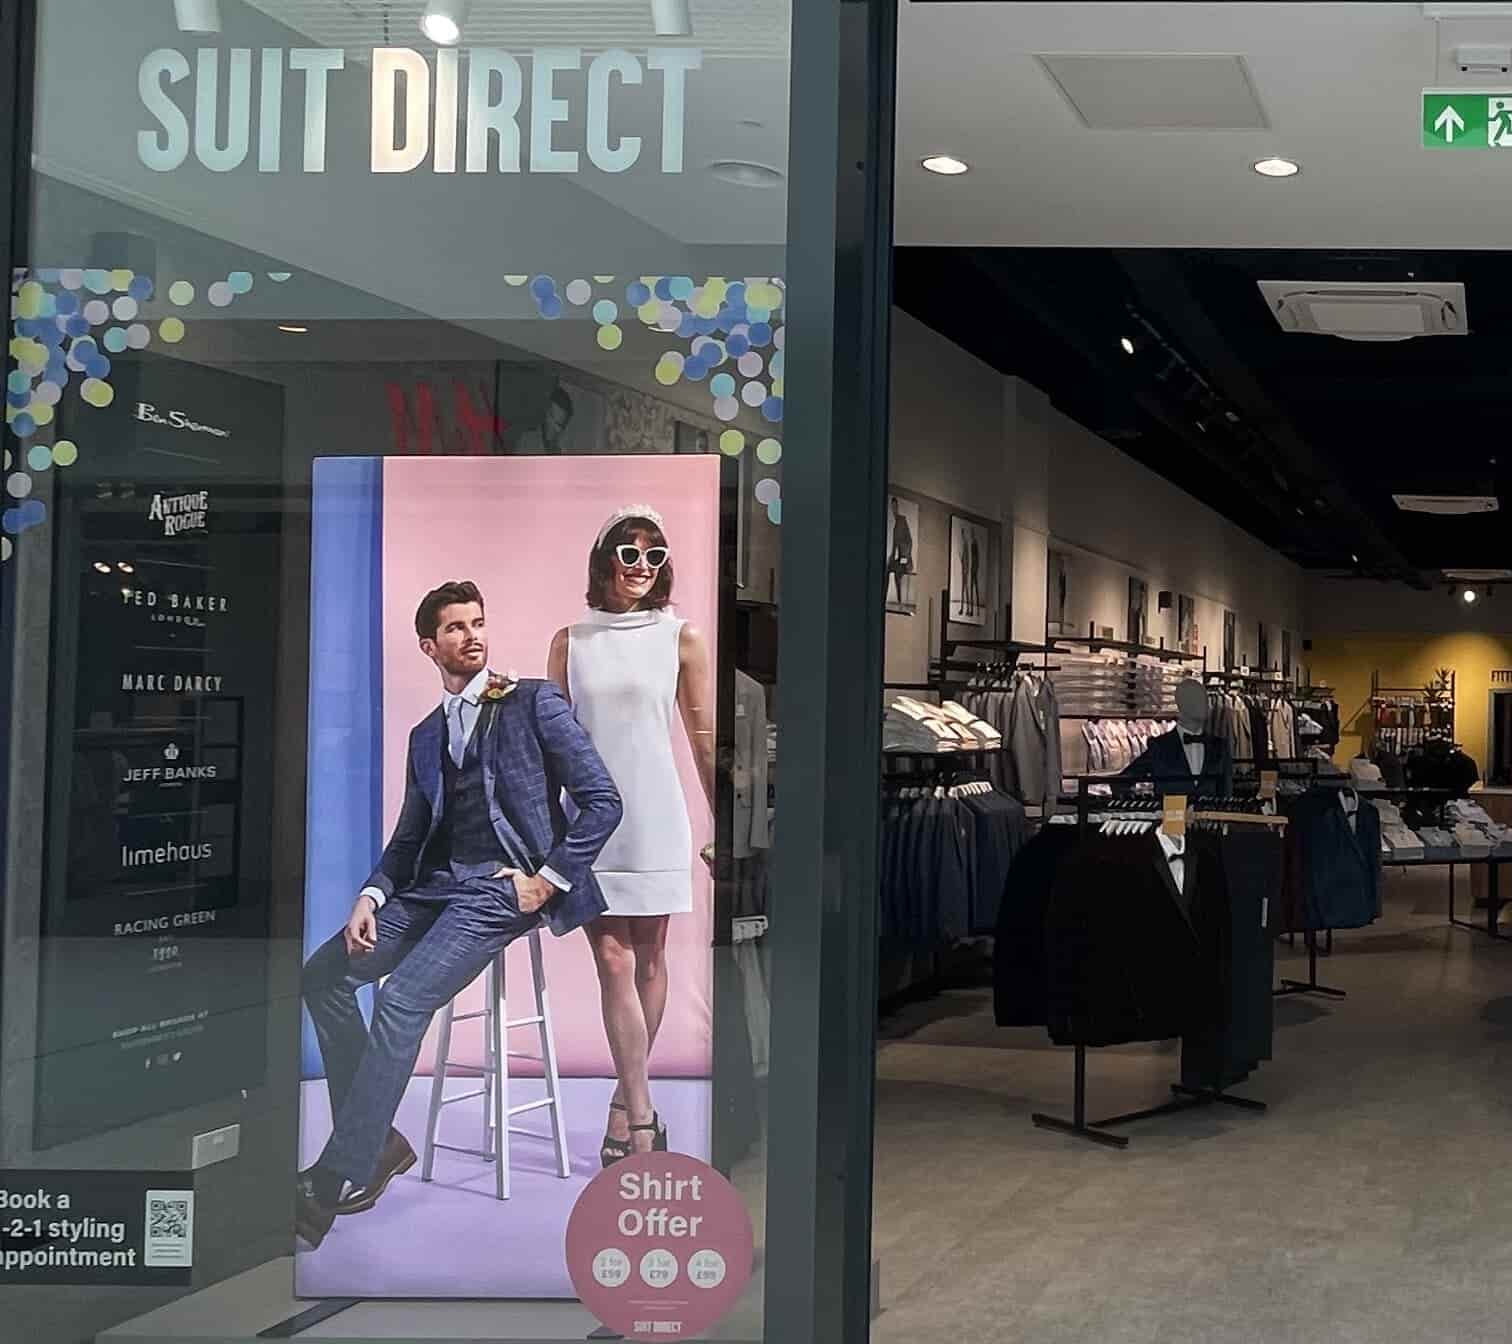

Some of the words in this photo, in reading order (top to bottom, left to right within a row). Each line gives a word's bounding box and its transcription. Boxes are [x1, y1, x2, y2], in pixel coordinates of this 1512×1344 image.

[137, 47, 345, 173] SUIT
[370, 47, 703, 174] DIRECT
[148, 490, 209, 521] ANTIQUE
[164, 511, 206, 536] ROGUE
[121, 588, 157, 607] TED
[170, 593, 228, 612] BAKER
[122, 673, 166, 692] MARC
[174, 674, 222, 692] DARCY
[122, 767, 161, 782] JEFF
[164, 765, 217, 780] BANKS
[122, 840, 213, 867] limehaus
[114, 915, 169, 936] RACING
[173, 909, 216, 927] GREEN
[0, 1189, 51, 1209] Book
[56, 1193, 70, 1209] a
[618, 1172, 703, 1201] Shirt
[2, 1219, 42, 1238] -2-1
[48, 1217, 125, 1243] styling
[617, 1207, 703, 1237] Offer
[0, 1246, 136, 1270] ppointment
